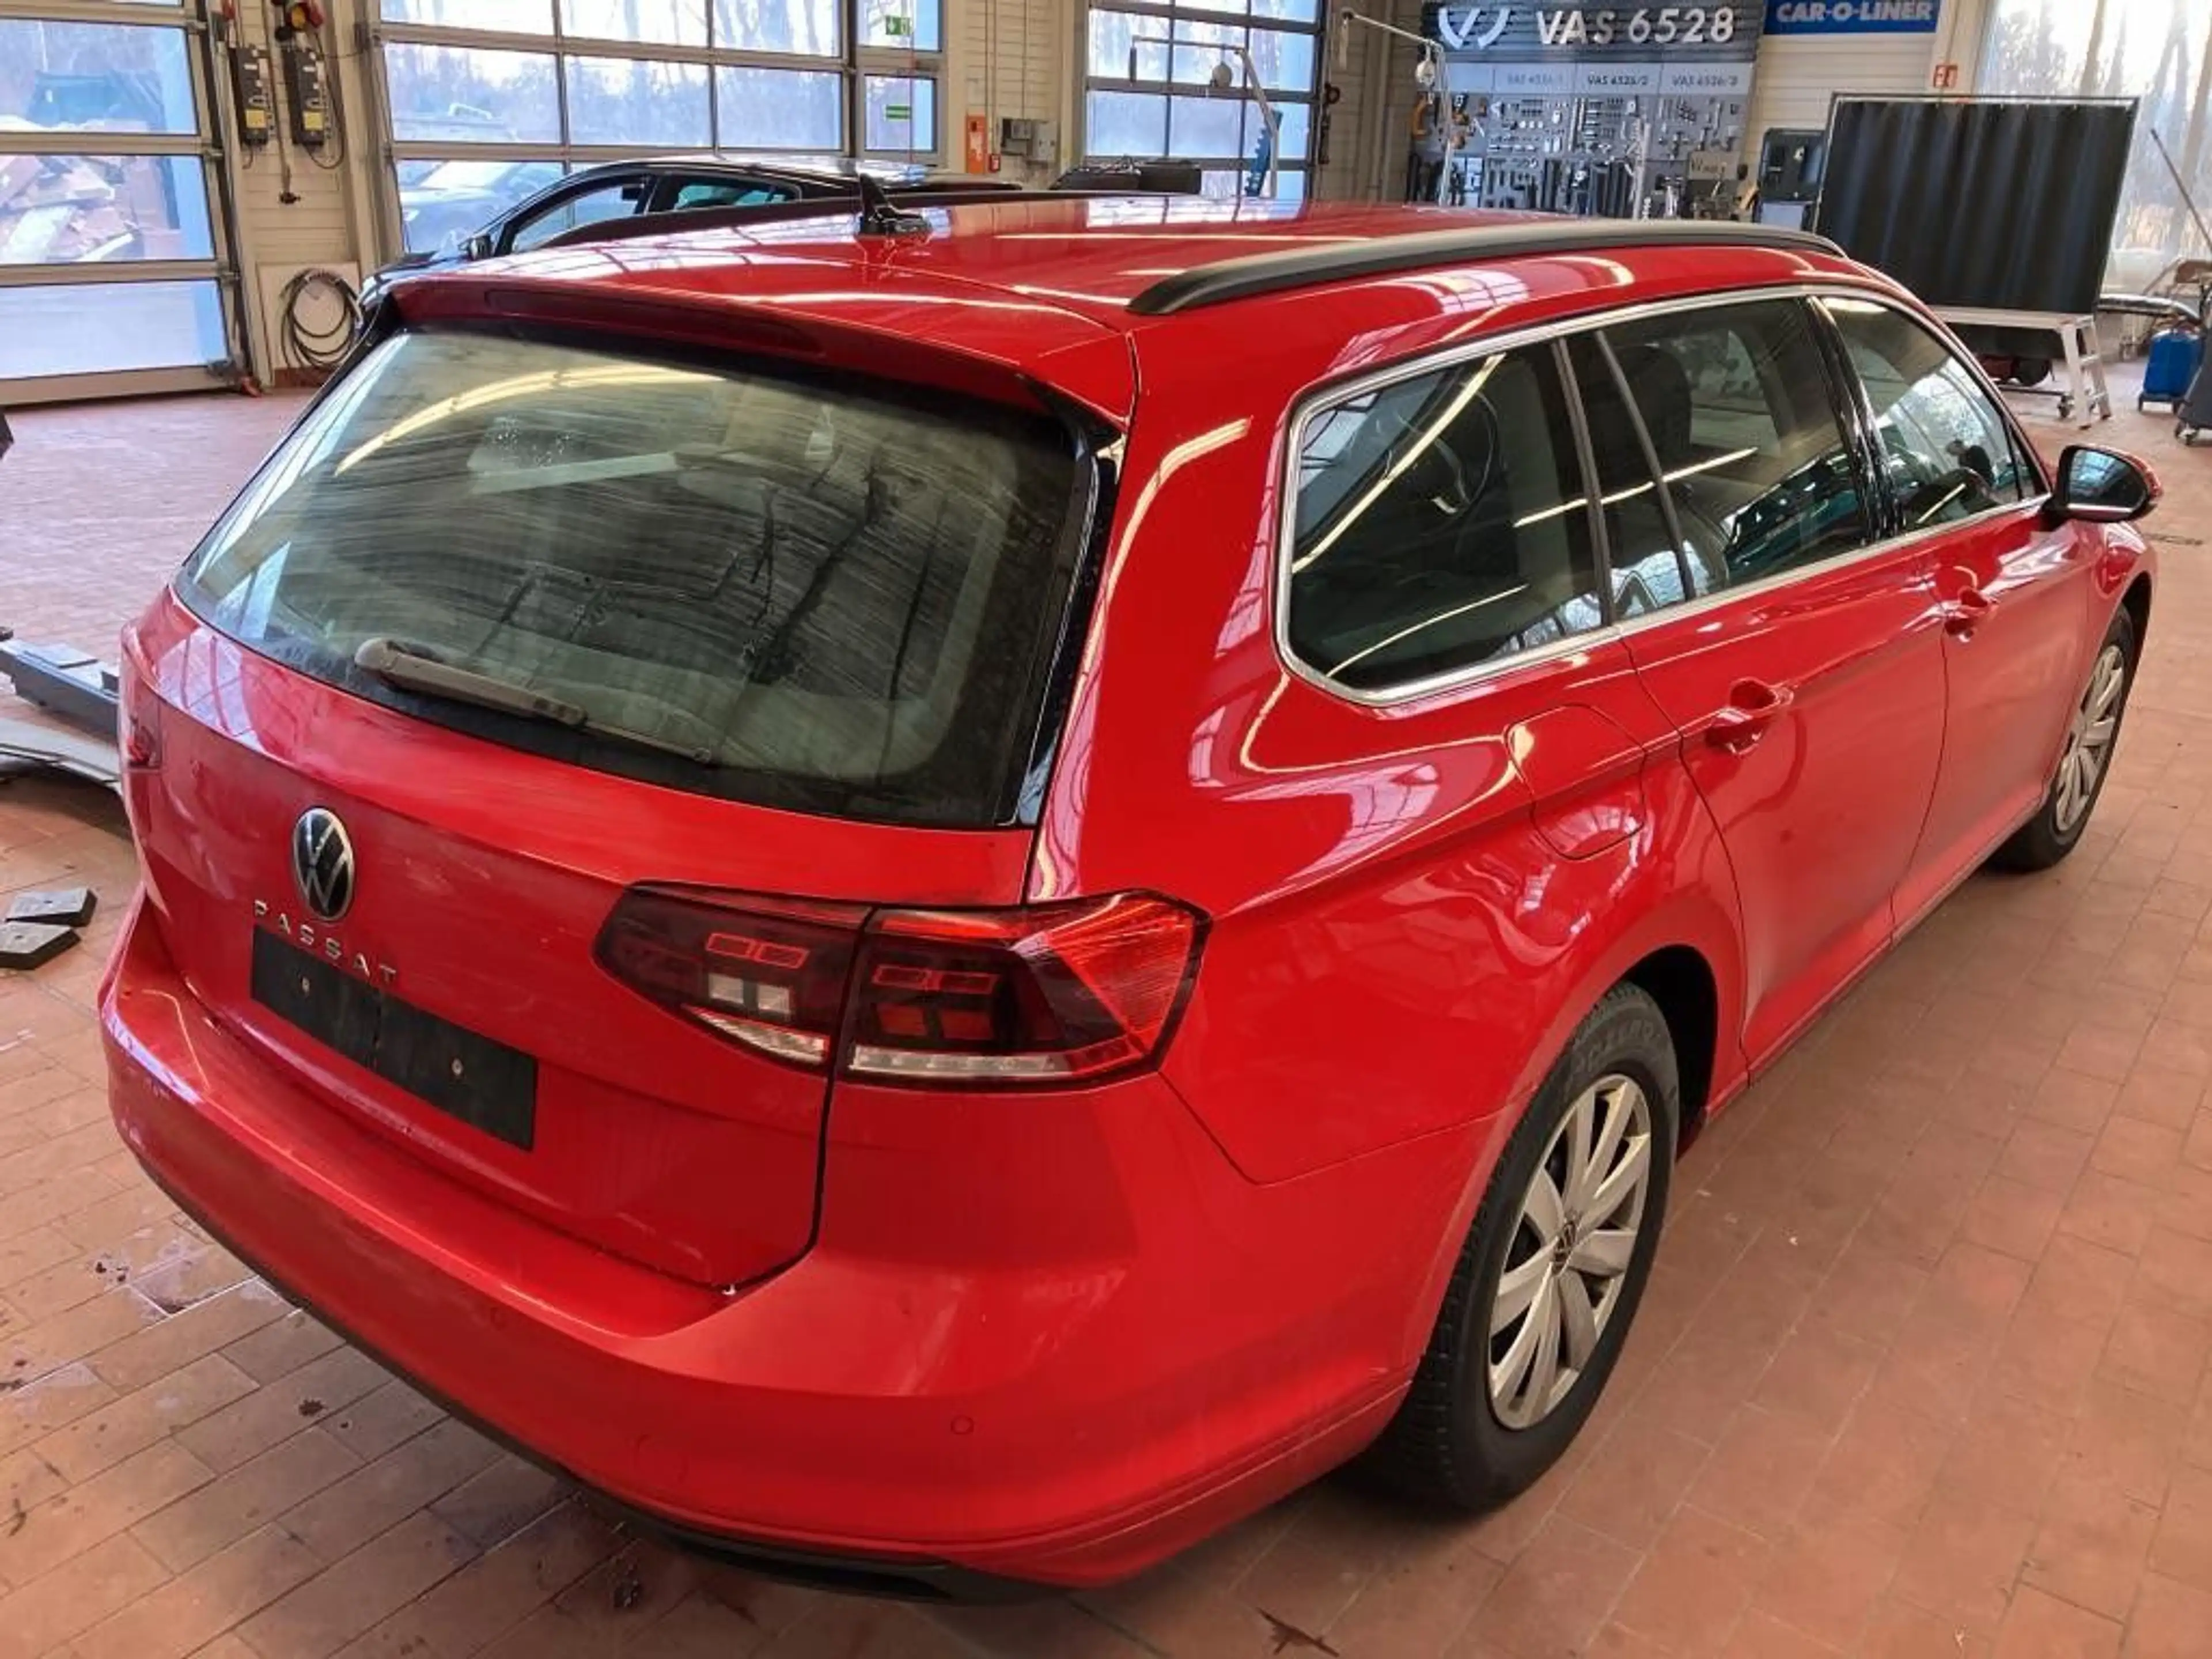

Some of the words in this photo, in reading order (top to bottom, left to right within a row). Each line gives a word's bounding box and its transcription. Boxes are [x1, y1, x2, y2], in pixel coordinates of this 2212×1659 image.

[1536, 10, 1615, 44] VAS
[1628, 6, 1734, 44] 6528
[1776, 2, 1933, 22] CAR-O-LINER
[1588, 75, 1608, 85] VAS
[254, 899, 397, 983] PASSAT
